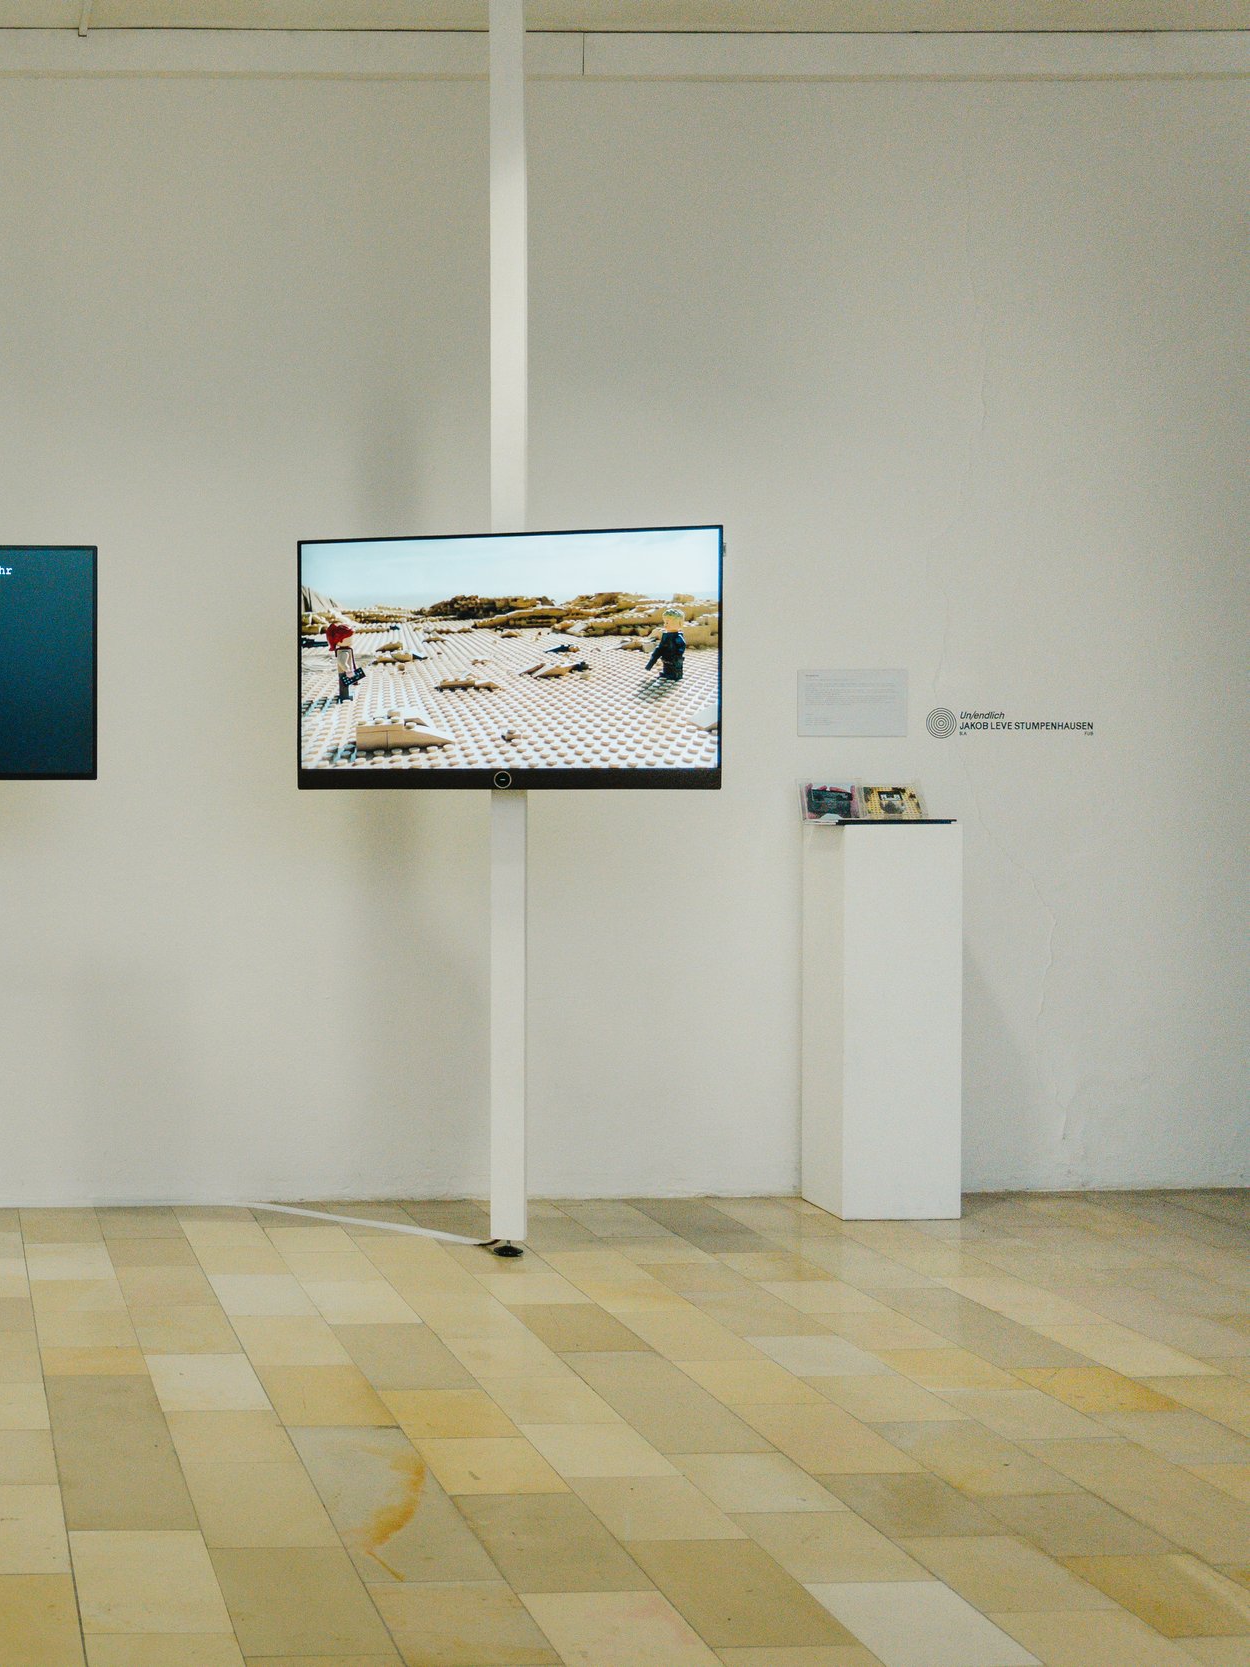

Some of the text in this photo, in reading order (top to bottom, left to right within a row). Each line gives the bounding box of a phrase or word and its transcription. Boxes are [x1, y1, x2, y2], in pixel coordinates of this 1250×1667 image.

[959, 711, 1005, 721] Un/endlich
[959, 721, 1094, 731] JAKOB LEVE STUMPENHAUSEN
